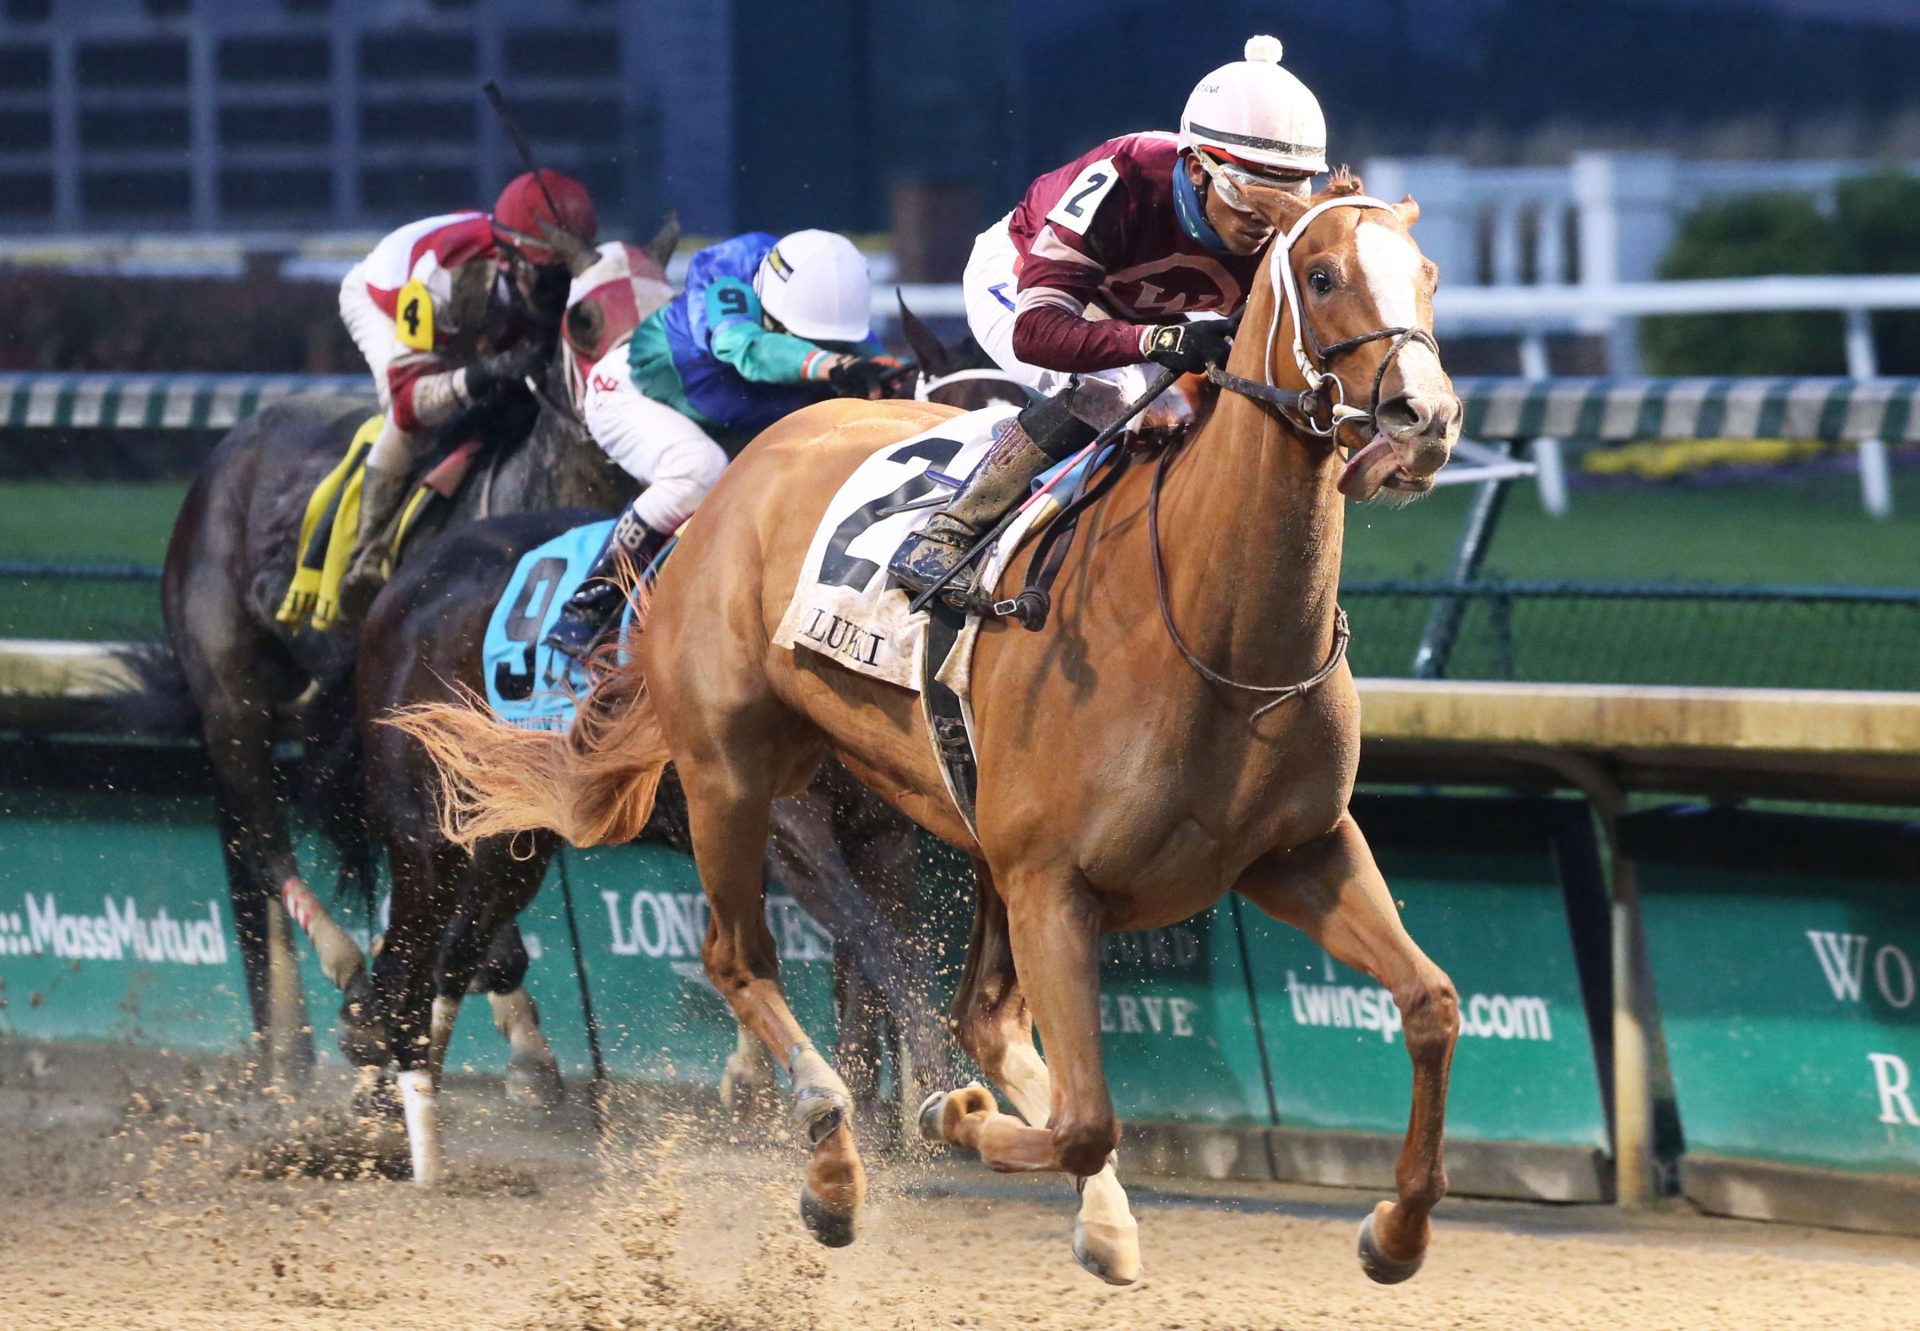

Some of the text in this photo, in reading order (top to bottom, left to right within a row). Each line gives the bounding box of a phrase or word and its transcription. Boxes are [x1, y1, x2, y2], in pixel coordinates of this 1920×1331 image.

[1064, 173, 1108, 218] 2
[403, 298, 420, 337] 4
[718, 288, 748, 316] 9
[817, 437, 964, 593] 2
[495, 557, 568, 701] 9
[25, 892, 228, 964] MassMutual
